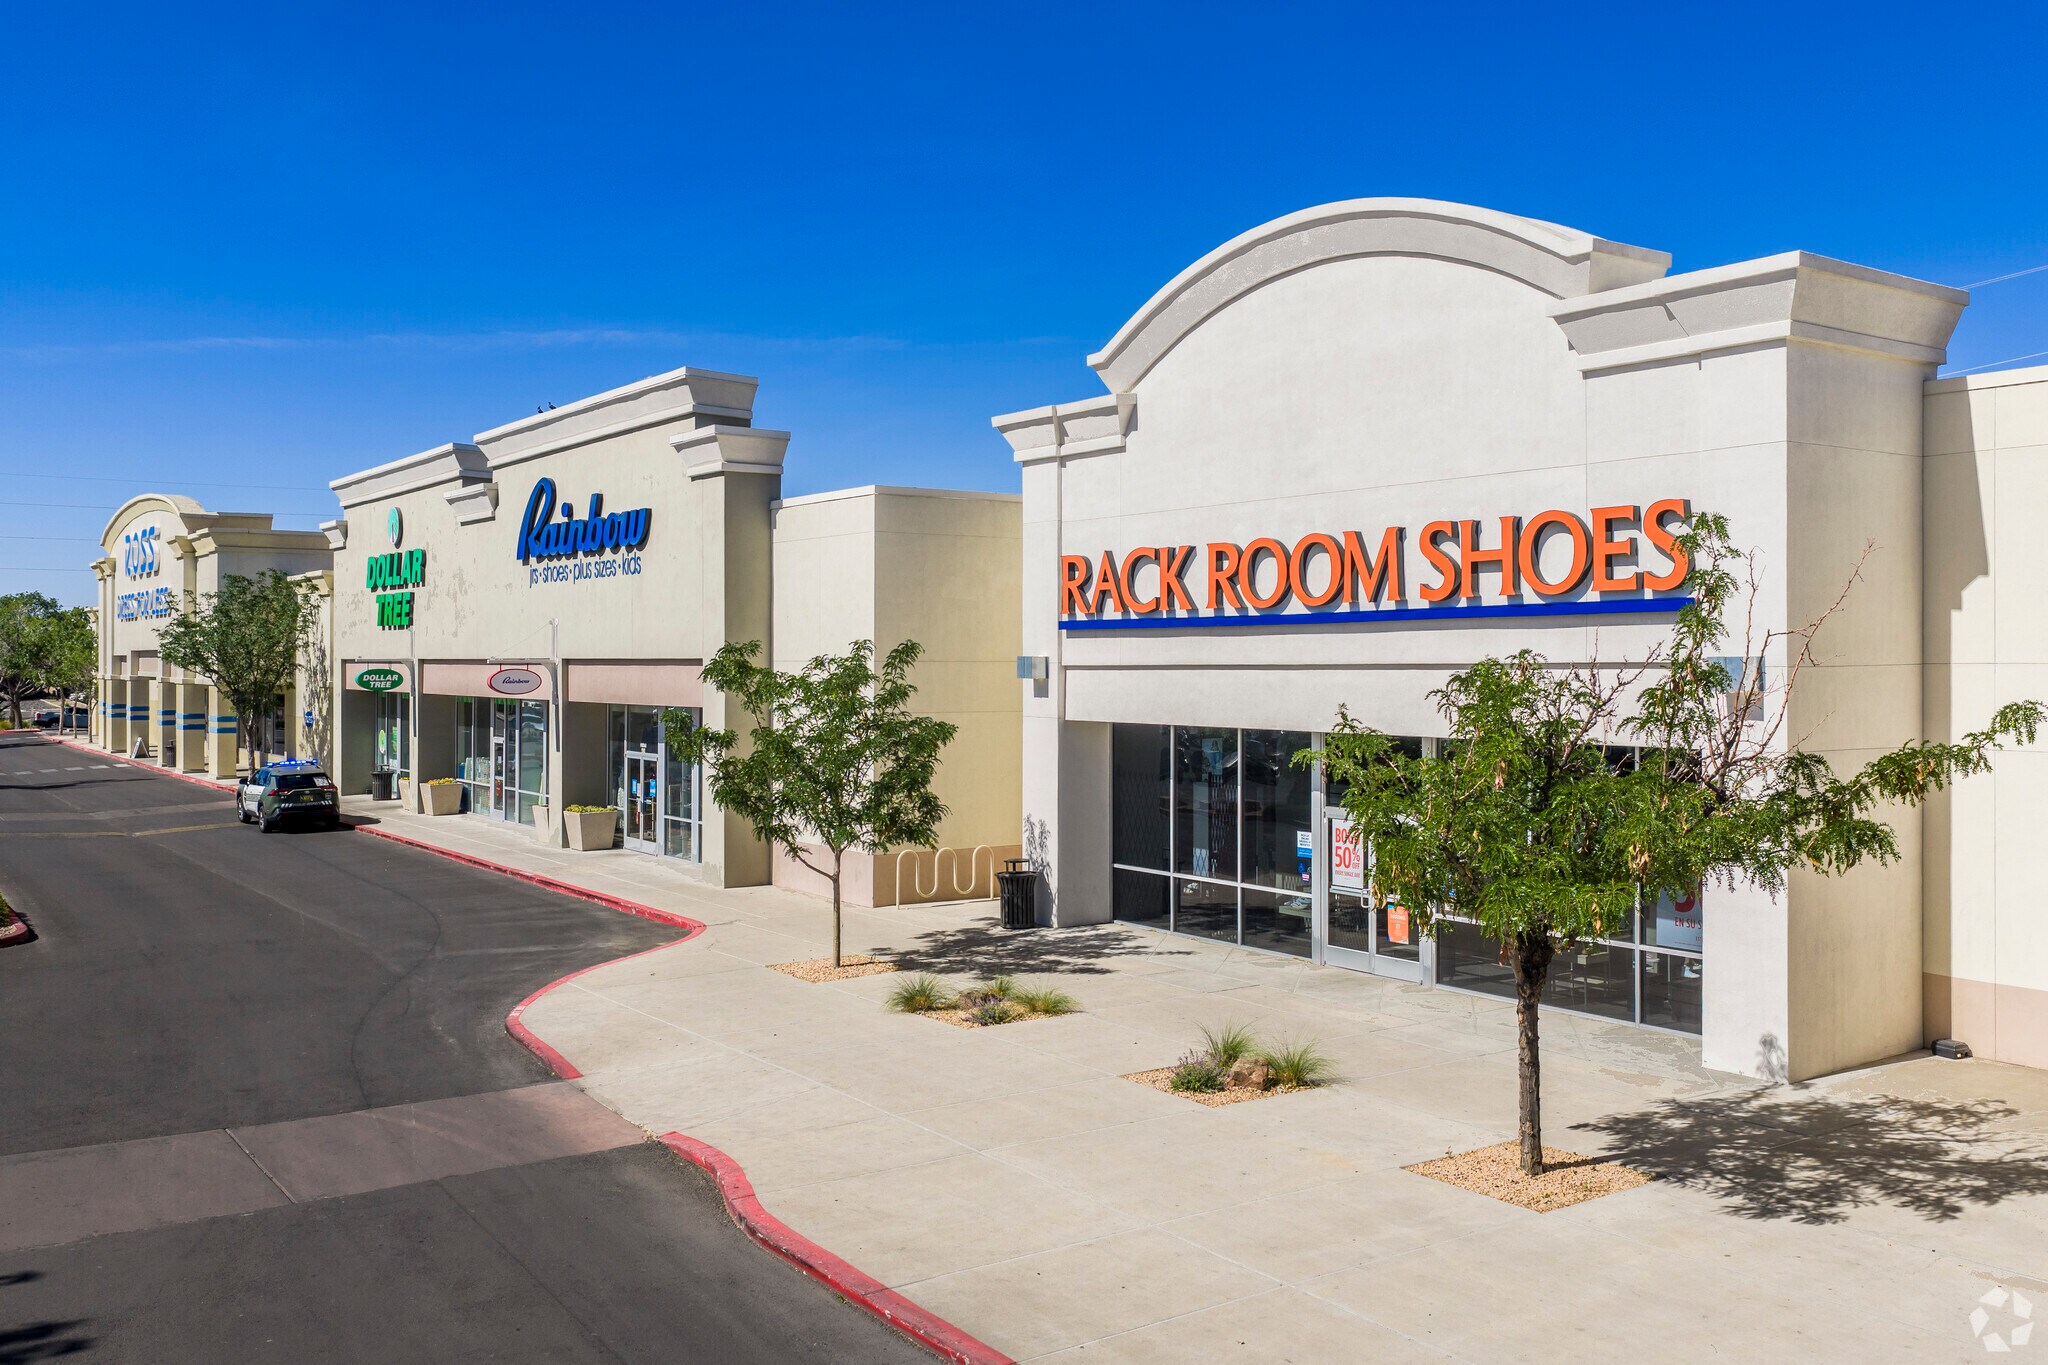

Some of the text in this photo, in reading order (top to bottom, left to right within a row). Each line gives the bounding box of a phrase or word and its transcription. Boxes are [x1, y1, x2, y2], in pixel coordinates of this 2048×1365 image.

[516, 477, 651, 562] Rainbow
[125, 526, 155, 577] ROSS
[366, 548, 424, 589] DOLLAR
[529, 552, 641, 589] jrs shoes plus sizes kids
[1060, 498, 1690, 614] RACK ROOM SHOES
[376, 591, 411, 627] TREE
[502, 676, 530, 684] Rainbow
[1675, 917, 1684, 927] EN
[1686, 918, 1695, 928] SU
